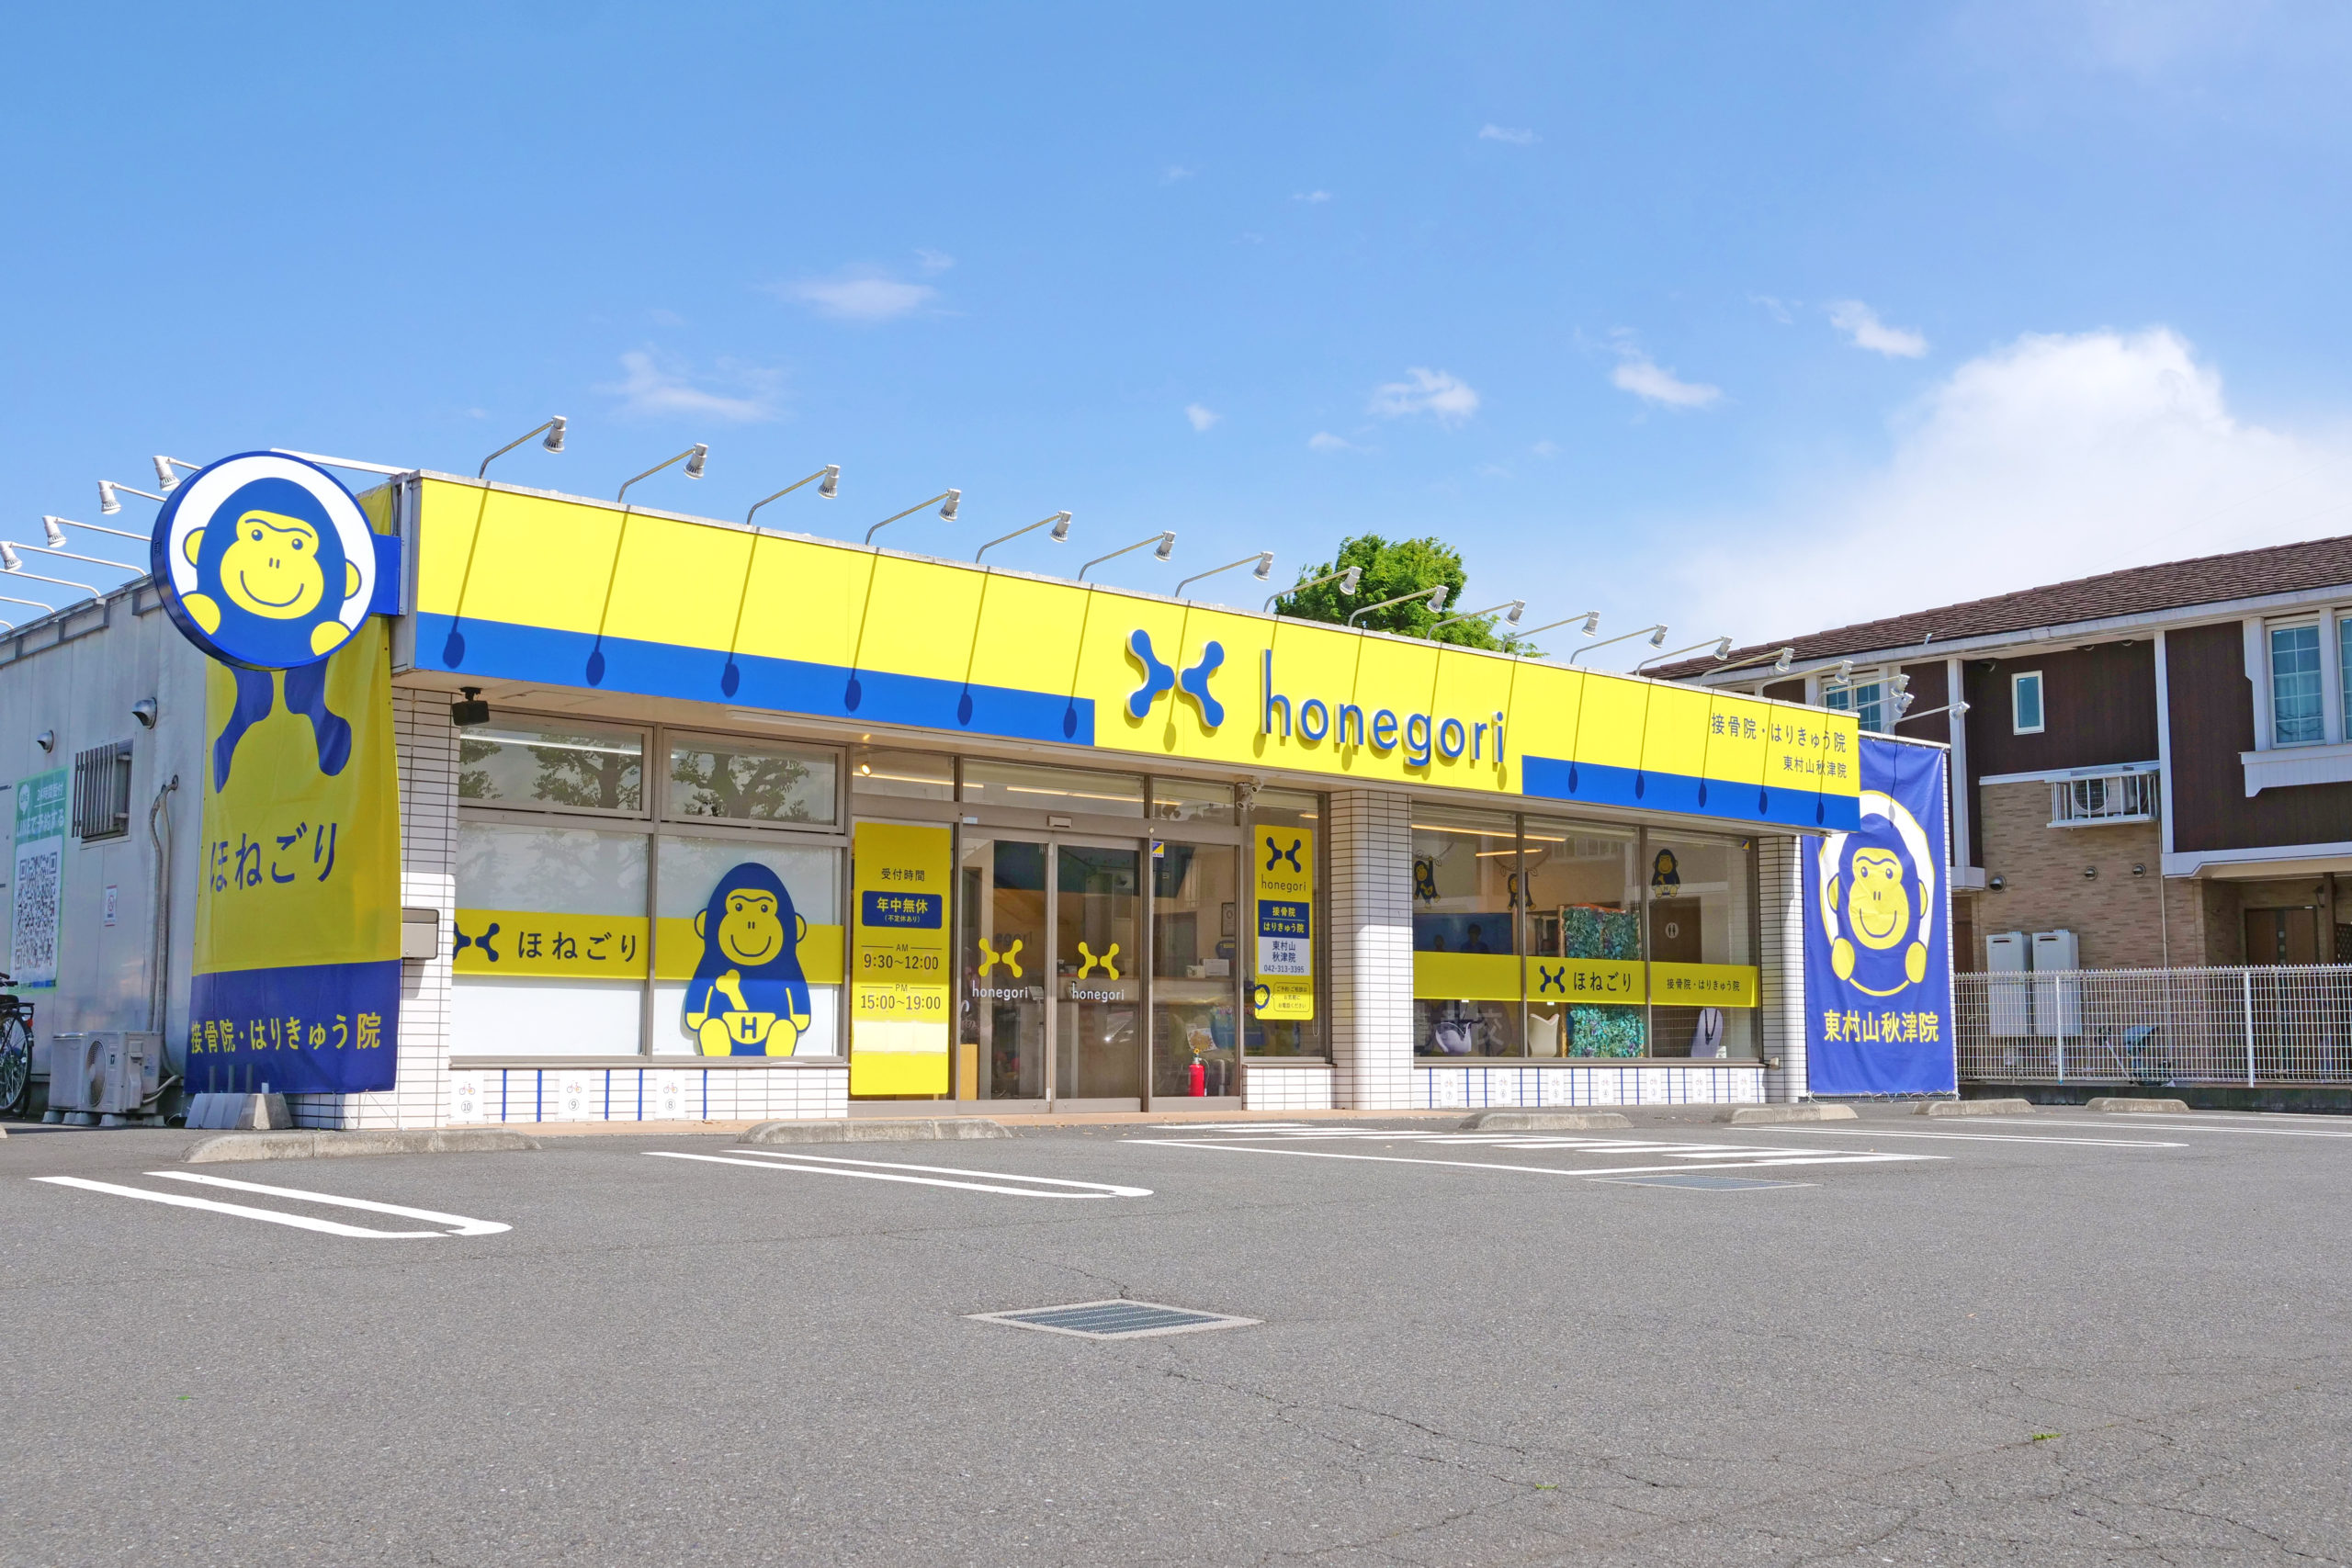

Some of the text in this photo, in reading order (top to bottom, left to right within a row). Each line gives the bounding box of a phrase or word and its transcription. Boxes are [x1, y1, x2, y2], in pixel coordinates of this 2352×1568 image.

[1261, 649, 1503, 767] honegori
[1712, 713, 1847, 753] 接骨院・はりきゅう院
[1783, 755, 1848, 779] 東村山秋津院
[209, 821, 337, 893] ほねごり
[881, 868, 925, 882] 受付時間
[1261, 874, 1306, 893] honegori
[876, 897, 929, 914] 年中無休
[1272, 907, 1296, 917] 接骨院
[1263, 921, 1305, 933] はりきゅう院
[518, 931, 637, 962] ほねごり
[896, 943, 909, 952] AM
[1272, 941, 1296, 951] 東村山
[1272, 952, 1296, 963] 秋津院
[1264, 964, 1305, 973] 042-313-3395
[895, 984, 908, 992] PM
[972, 979, 1028, 1000] honegori
[1573, 971, 1631, 992] ほねごり
[1667, 978, 1740, 992] 接骨院・はりきゅう院
[1072, 982, 1125, 1003] honegori
[191, 1012, 381, 1055] 接骨院・はりきゅう院
[741, 1016, 757, 1039] H
[1824, 1009, 1939, 1043] 東村山秋津院
